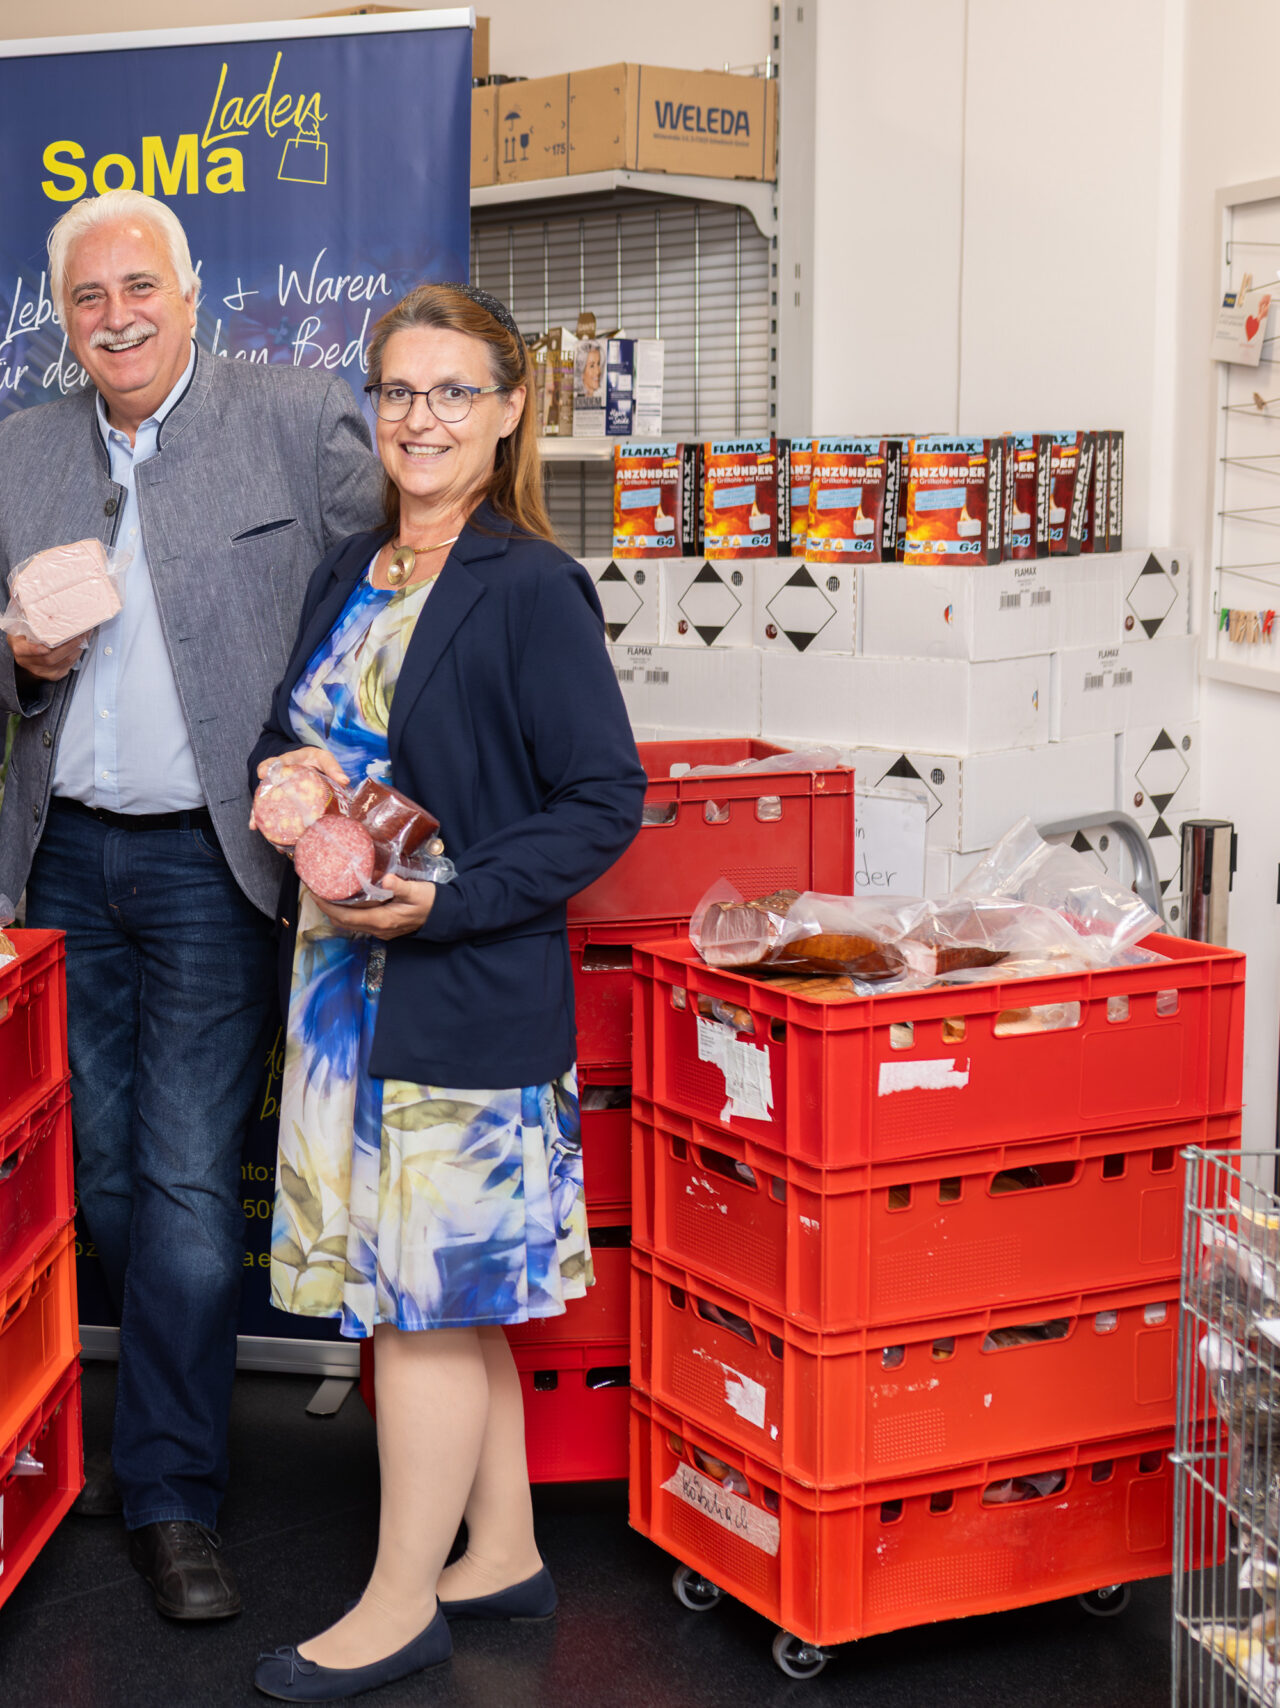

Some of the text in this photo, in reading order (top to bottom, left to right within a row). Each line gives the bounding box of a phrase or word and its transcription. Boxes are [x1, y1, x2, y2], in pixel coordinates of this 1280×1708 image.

[201, 51, 328, 149] Laden
[654, 100, 750, 136] WELEDA
[41, 134, 246, 202] SoMa
[278, 247, 392, 307] Waren
[622, 448, 670, 457] FLAMAX
[713, 442, 764, 454] FLAMAX
[820, 444, 871, 452] FLAMAX
[916, 443, 976, 452] FLAMAX
[616, 468, 678, 480] ANZÜNDER
[708, 464, 774, 478] ANZÜNDER
[812, 466, 882, 478] ANZÜNDER
[910, 465, 986, 478] ANZÜNDER
[656, 536, 674, 546] 64
[751, 536, 769, 546] 64
[854, 540, 872, 550] 64
[959, 542, 980, 552] 64
[1014, 566, 1037, 577] FLAMAX
[627, 648, 652, 656] FLAMAX
[1098, 648, 1120, 659] FLAMAX
